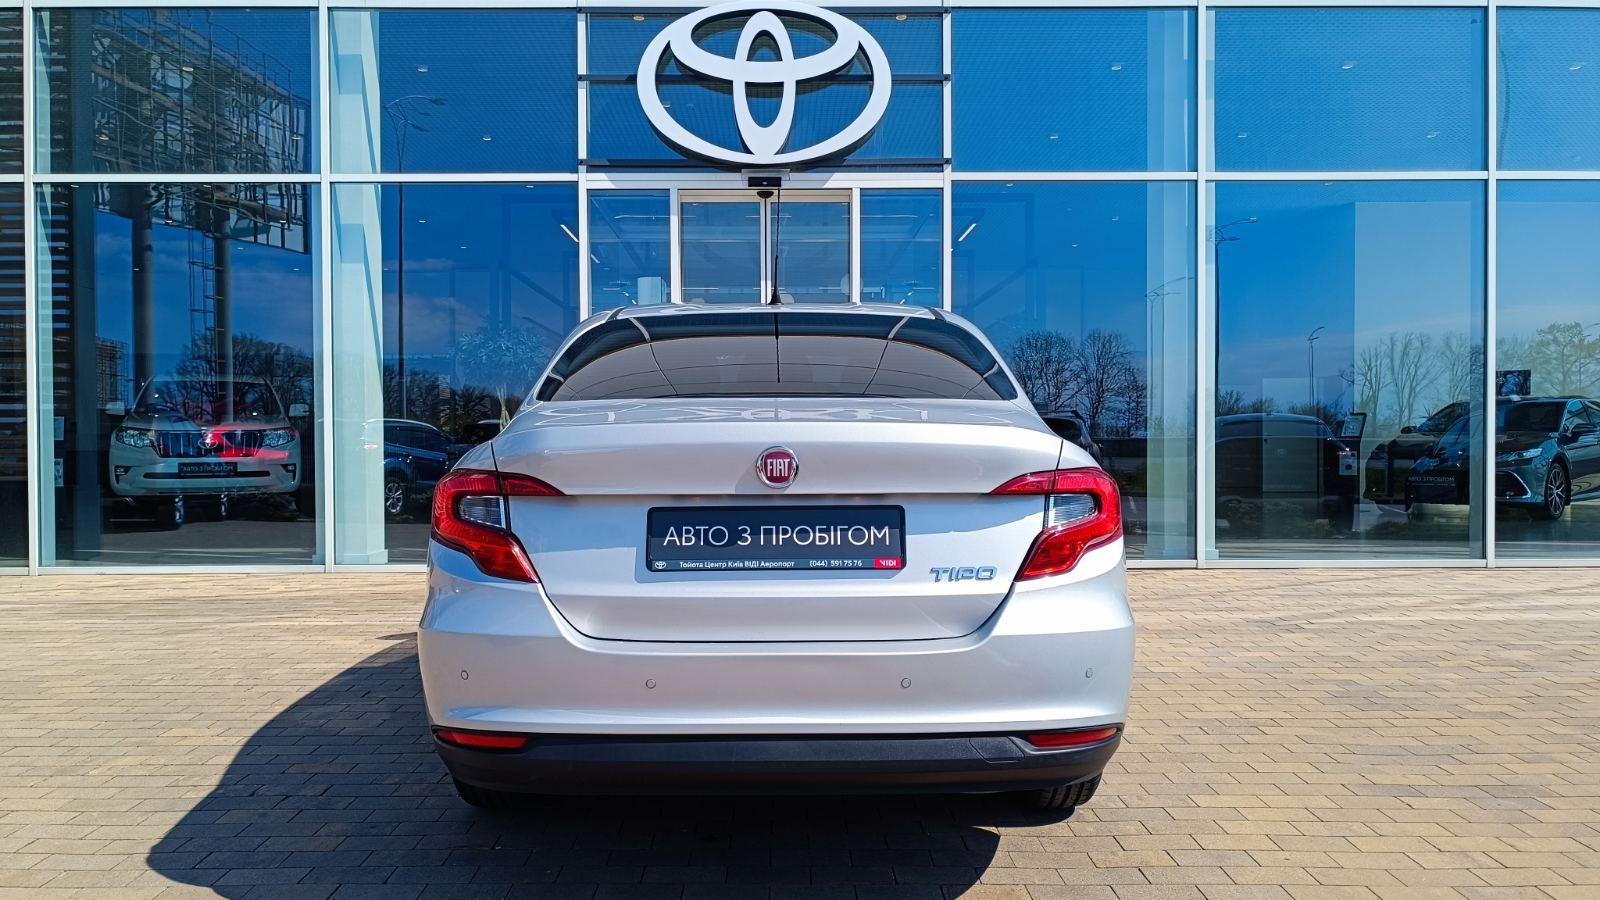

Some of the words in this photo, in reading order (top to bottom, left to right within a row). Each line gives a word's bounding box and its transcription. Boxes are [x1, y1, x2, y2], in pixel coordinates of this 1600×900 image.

[766, 458, 791, 477] FIAT
[663, 525, 729, 546] АВТО
[737, 526, 751, 546] З
[760, 525, 890, 546] ПРОБІГОМ
[704, 561, 727, 569] Центр
[760, 560, 795, 569] Аеропорт
[809, 559, 828, 568] (044)
[830, 559, 842, 567] 591
[843, 559, 853, 567] 75
[853, 559, 863, 567] 76
[879, 559, 897, 567] VIDI
[929, 565, 998, 583] TIPO
